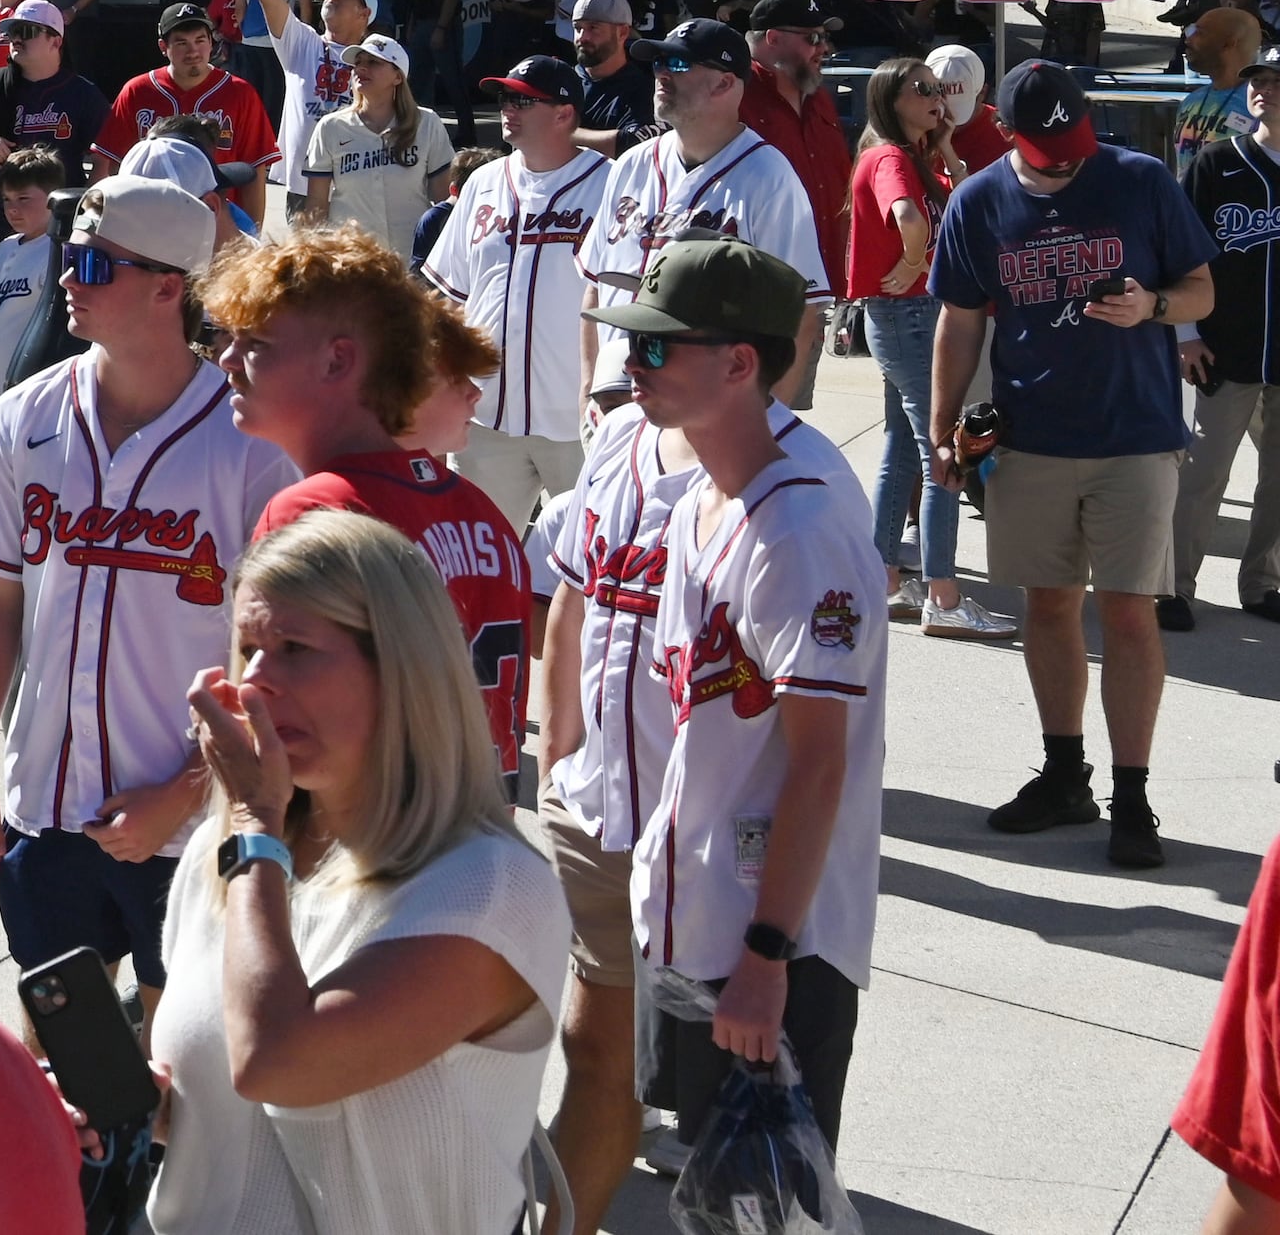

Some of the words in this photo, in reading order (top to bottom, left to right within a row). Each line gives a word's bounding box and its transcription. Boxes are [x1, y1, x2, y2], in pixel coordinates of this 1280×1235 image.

[340, 152, 360, 175] LOS
[471, 203, 585, 247] Braves
[1024, 232, 1085, 249] CHAMPIONS
[998, 236, 1125, 286] DEFEND
[1007, 278, 1058, 307] THE
[1062, 270, 1112, 300] AT
[22, 482, 201, 566] Braves
